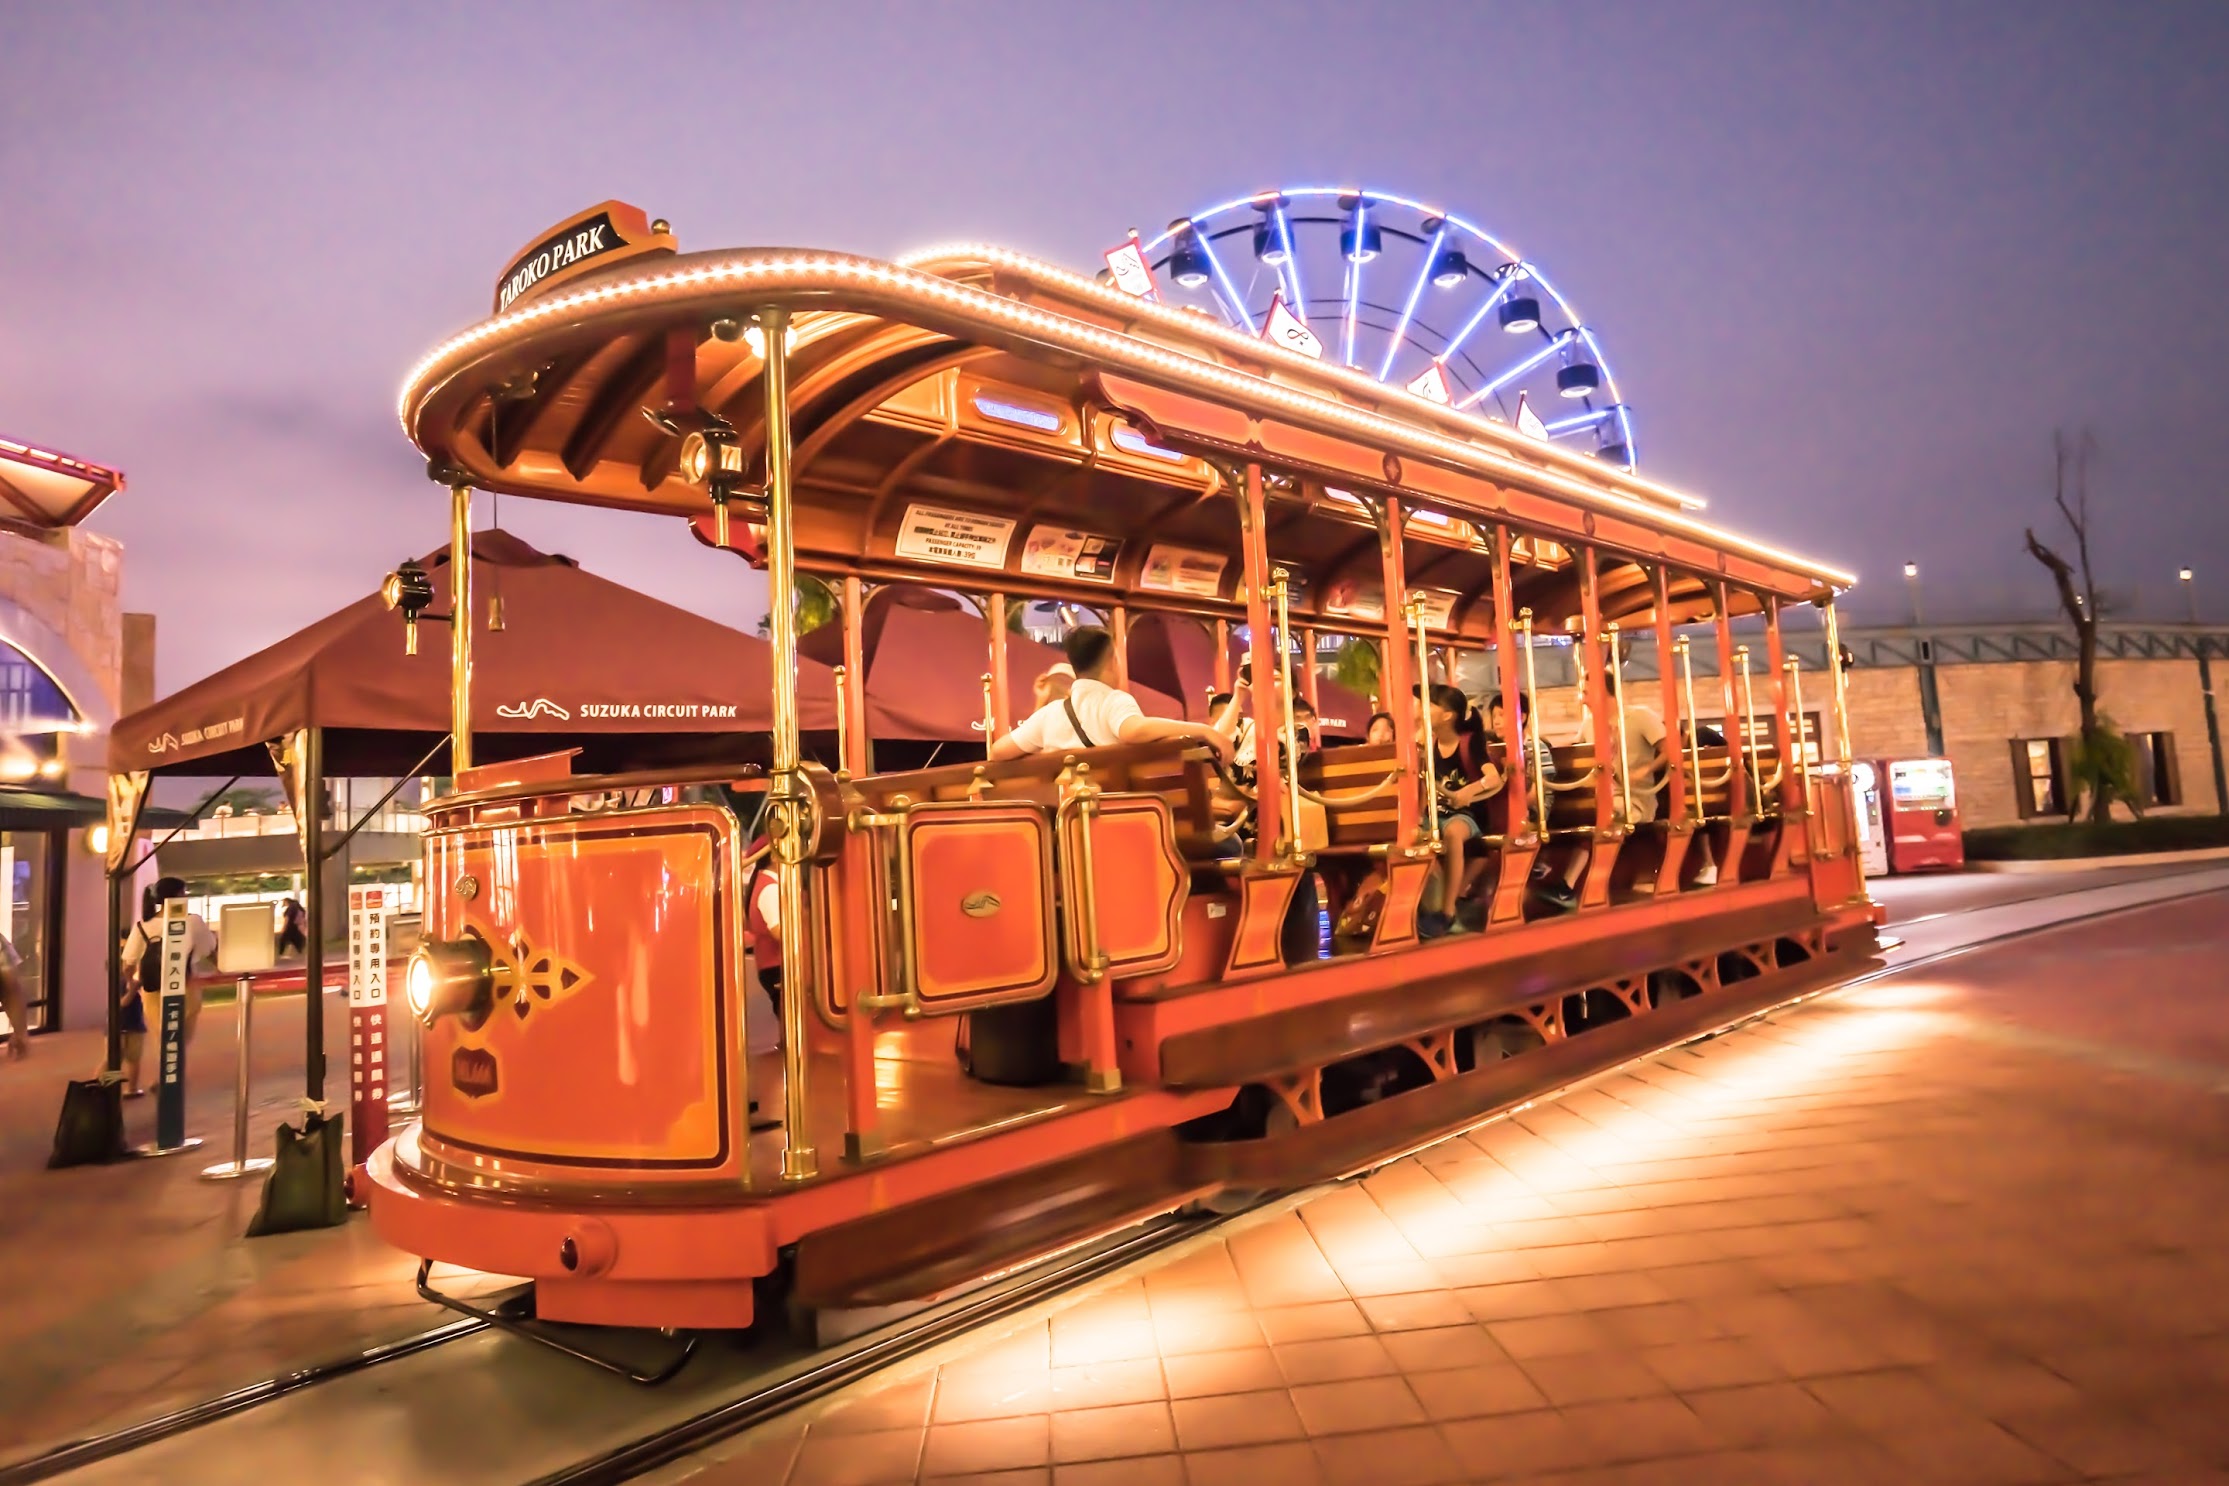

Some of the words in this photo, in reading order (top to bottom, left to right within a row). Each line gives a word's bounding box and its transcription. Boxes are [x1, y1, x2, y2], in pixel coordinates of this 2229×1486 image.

[500, 253, 550, 313] TAROKO
[552, 224, 605, 271] PARK
[580, 704, 639, 718] SUZUKA
[643, 704, 698, 718] CIRCUIT
[702, 705, 737, 718] PARK
[369, 913, 380, 999] 預約專用入口
